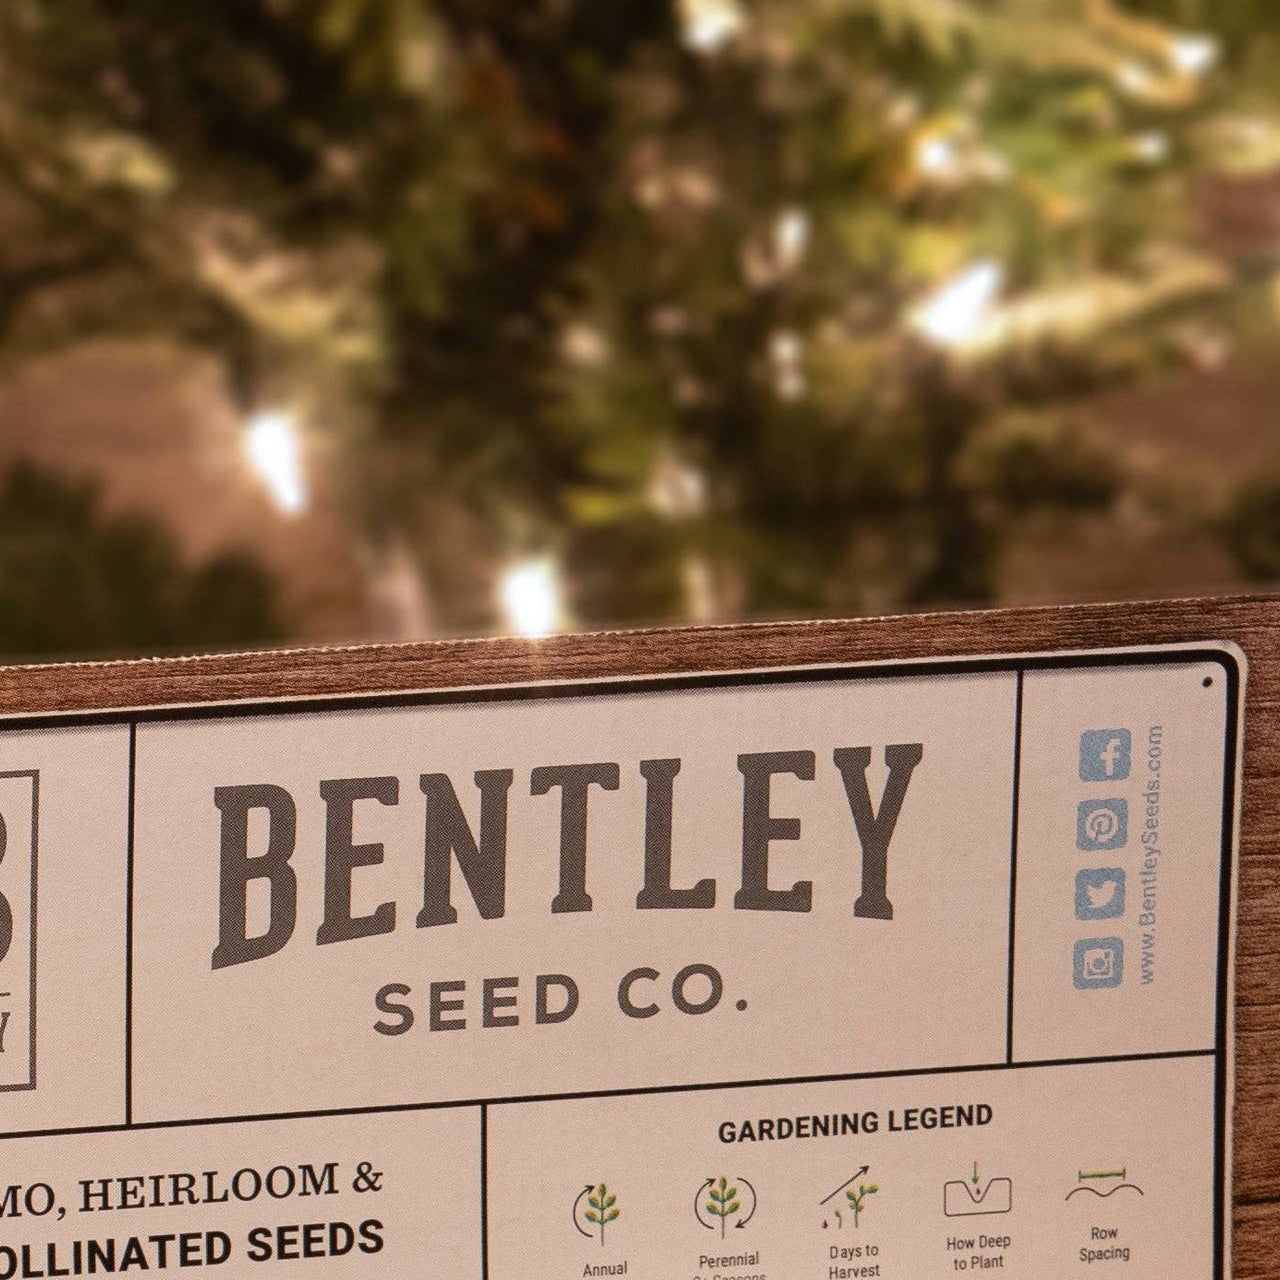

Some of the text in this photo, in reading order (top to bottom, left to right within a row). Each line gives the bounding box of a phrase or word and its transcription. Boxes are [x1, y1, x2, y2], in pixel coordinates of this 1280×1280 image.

[211, 742, 923, 971] BENTLEY
[1138, 725, 1163, 986] www.BentleySeeds.com
[373, 963, 749, 1036] SEED CO.
[718, 1103, 993, 1144] GARDENING LEGEND
[78, 1162, 339, 1213] HEIRLOOM
[352, 1161, 383, 1192] &
[246, 1219, 384, 1262] SEEDS
[1091, 1227, 1118, 1240] Row
[947, 1235, 1011, 1251] How Deep
[699, 1252, 759, 1269] Perennial
[830, 1245, 879, 1261] Days to
[1080, 1246, 1130, 1264] Spacing
[583, 1261, 628, 1278] Annual
[954, 1255, 1004, 1271] to Plant
[829, 1265, 880, 1280] Harvest
